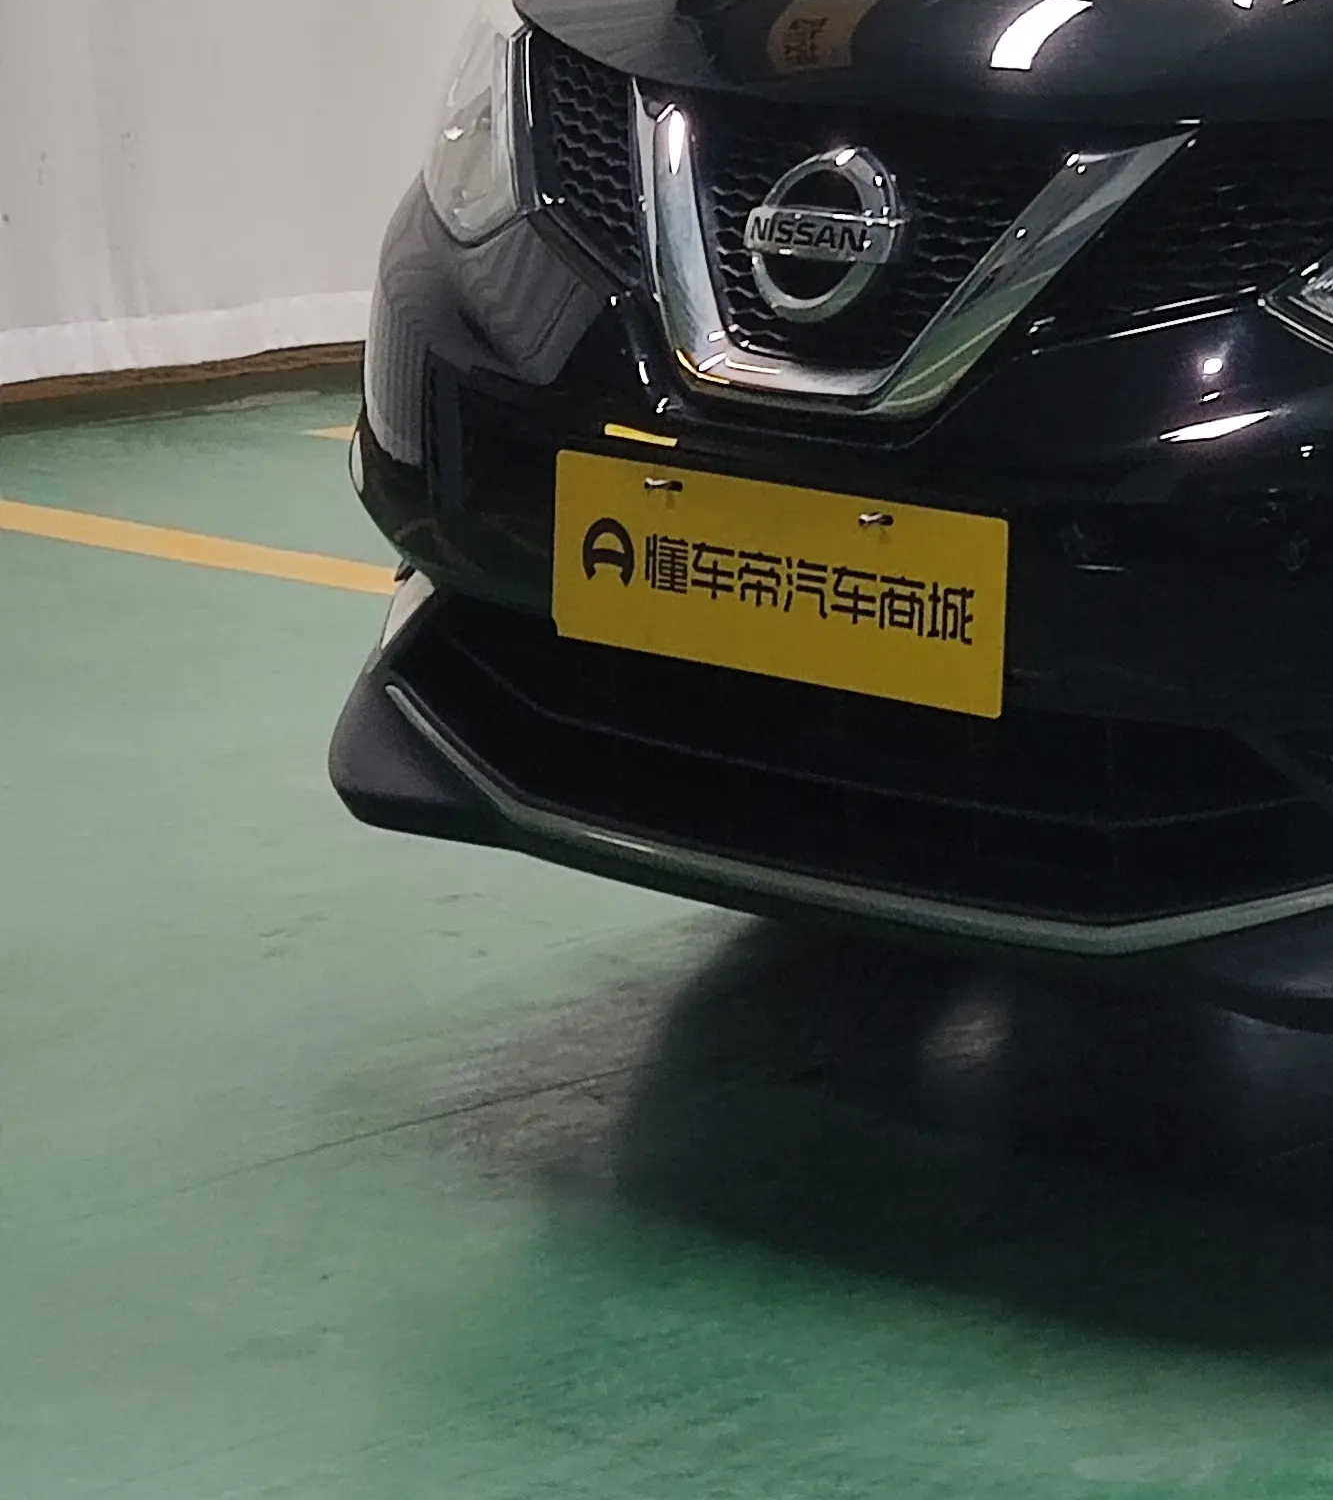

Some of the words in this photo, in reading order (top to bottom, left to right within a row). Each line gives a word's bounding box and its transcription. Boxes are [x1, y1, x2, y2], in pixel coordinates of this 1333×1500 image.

[750, 216, 867, 252] NISSAN
[644, 533, 975, 645] 懂车帝汽车商城
